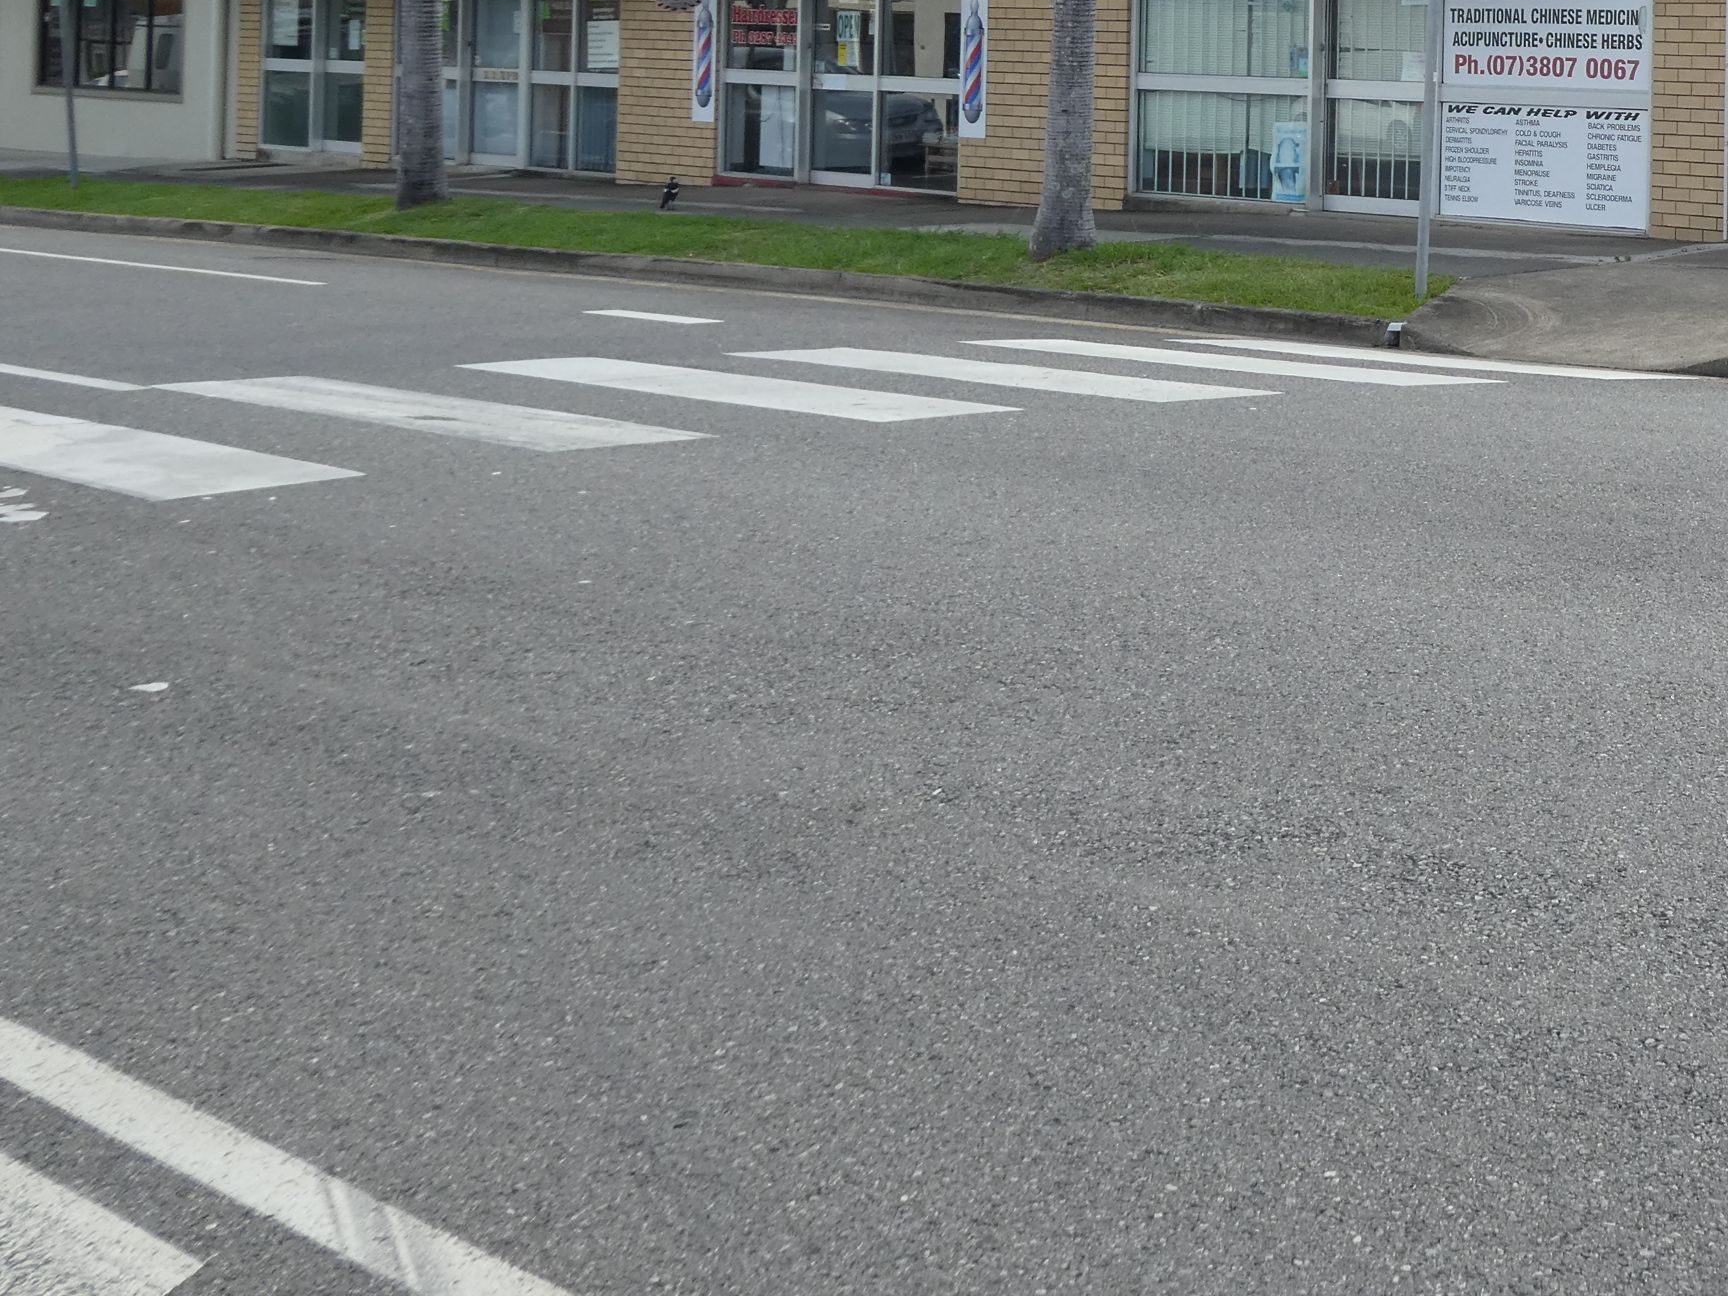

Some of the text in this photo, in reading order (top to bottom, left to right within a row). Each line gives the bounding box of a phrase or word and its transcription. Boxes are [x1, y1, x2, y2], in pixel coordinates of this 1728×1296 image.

[1450, 8, 1640, 26] TRADITIONAL CHINESE MEDICIN
[838, 14, 860, 40] OPEN
[1546, 33, 1597, 49] CHINESE
[1601, 34, 1643, 50] HERBS
[1454, 54, 1640, 81] Ph.(07)3807 0067
[1447, 104, 1640, 121] WE CAN HELP WITH
[1515, 119, 1540, 127] ASTHMA
[1587, 122, 1641, 132] BACK PROBLEMS
[1515, 129, 1532, 137] COLD
[1587, 133, 1642, 143] CHRONIC FATIGUE
[1515, 139, 1535, 147] FACIAL
[1587, 143, 1617, 151] DIABETES
[1587, 153, 1619, 161] GASTRITIS
[1514, 169, 1550, 177] MENOPAUSE
[1586, 173, 1616, 181] MIGRAINE
[1586, 183, 1613, 191] SCIATICA
[1543, 191, 1575, 199] DEAFNESS
[1586, 194, 1633, 202] SCLERODERMA
[1514, 199, 1544, 207] VARICOSE
[1585, 203, 1606, 211] ULCER
